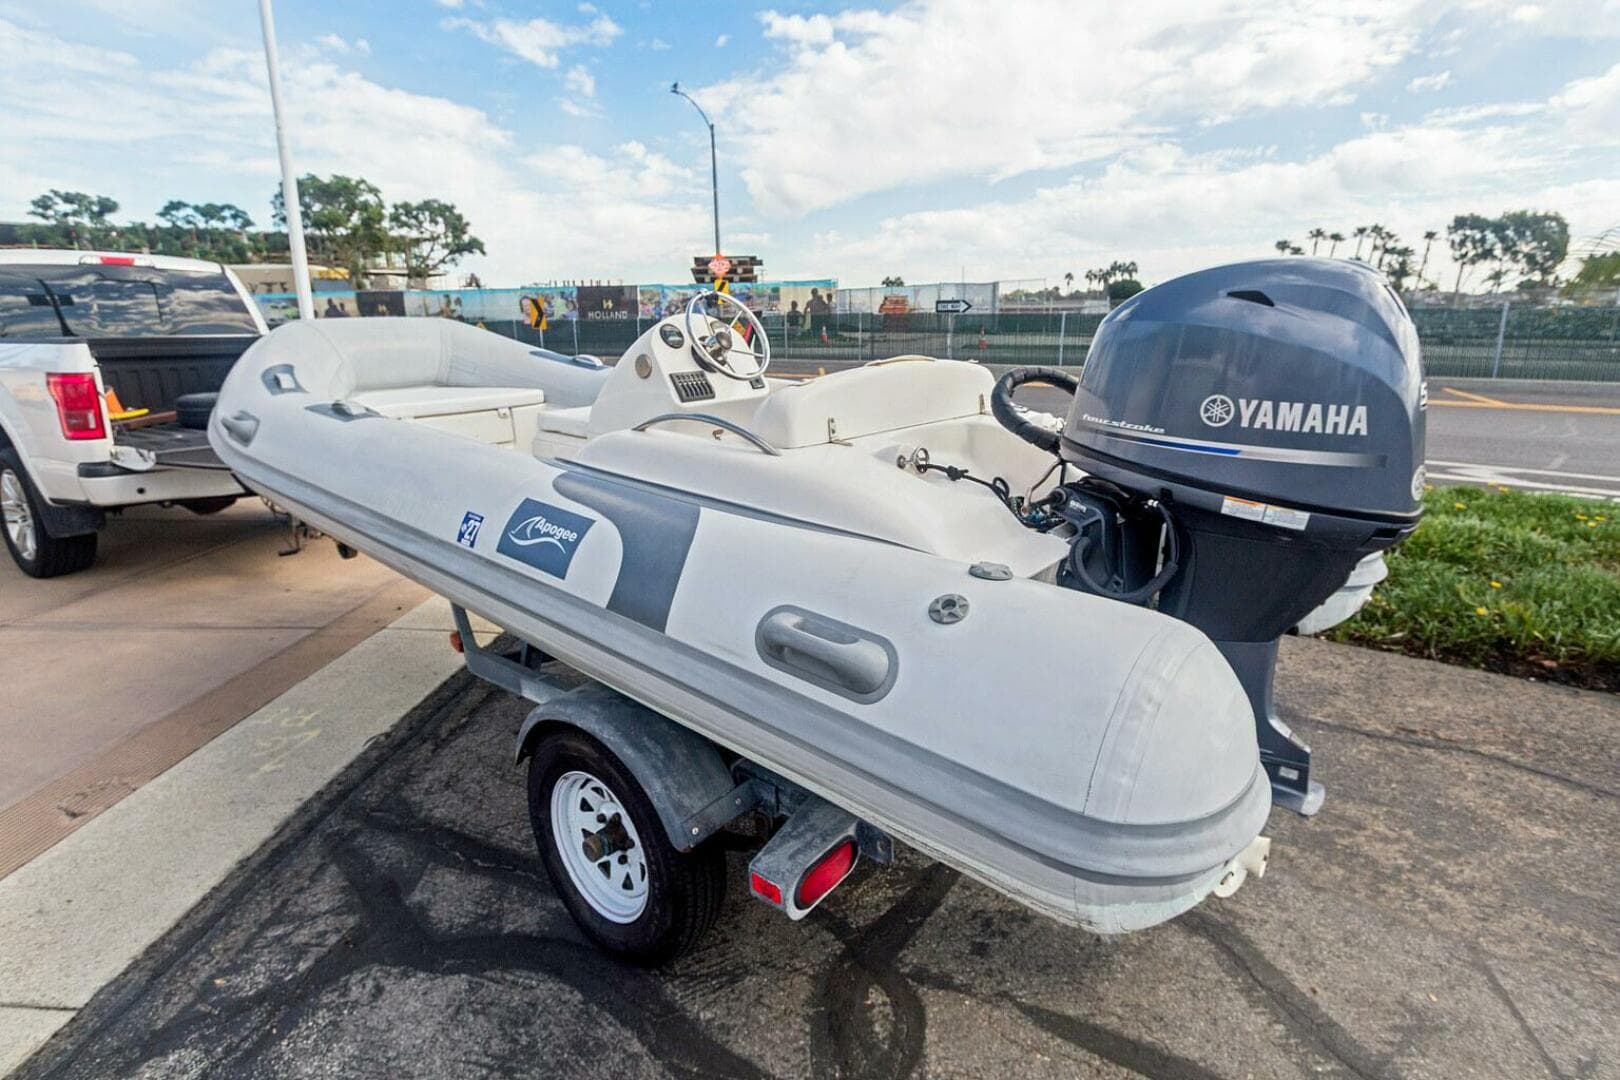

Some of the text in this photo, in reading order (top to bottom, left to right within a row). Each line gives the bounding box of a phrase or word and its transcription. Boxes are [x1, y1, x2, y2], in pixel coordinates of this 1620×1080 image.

[588, 310, 628, 320] HOLLAND
[1082, 413, 1165, 434] fourstroke
[1238, 398, 1368, 436] YAMAHA
[534, 517, 578, 542] Apogee
